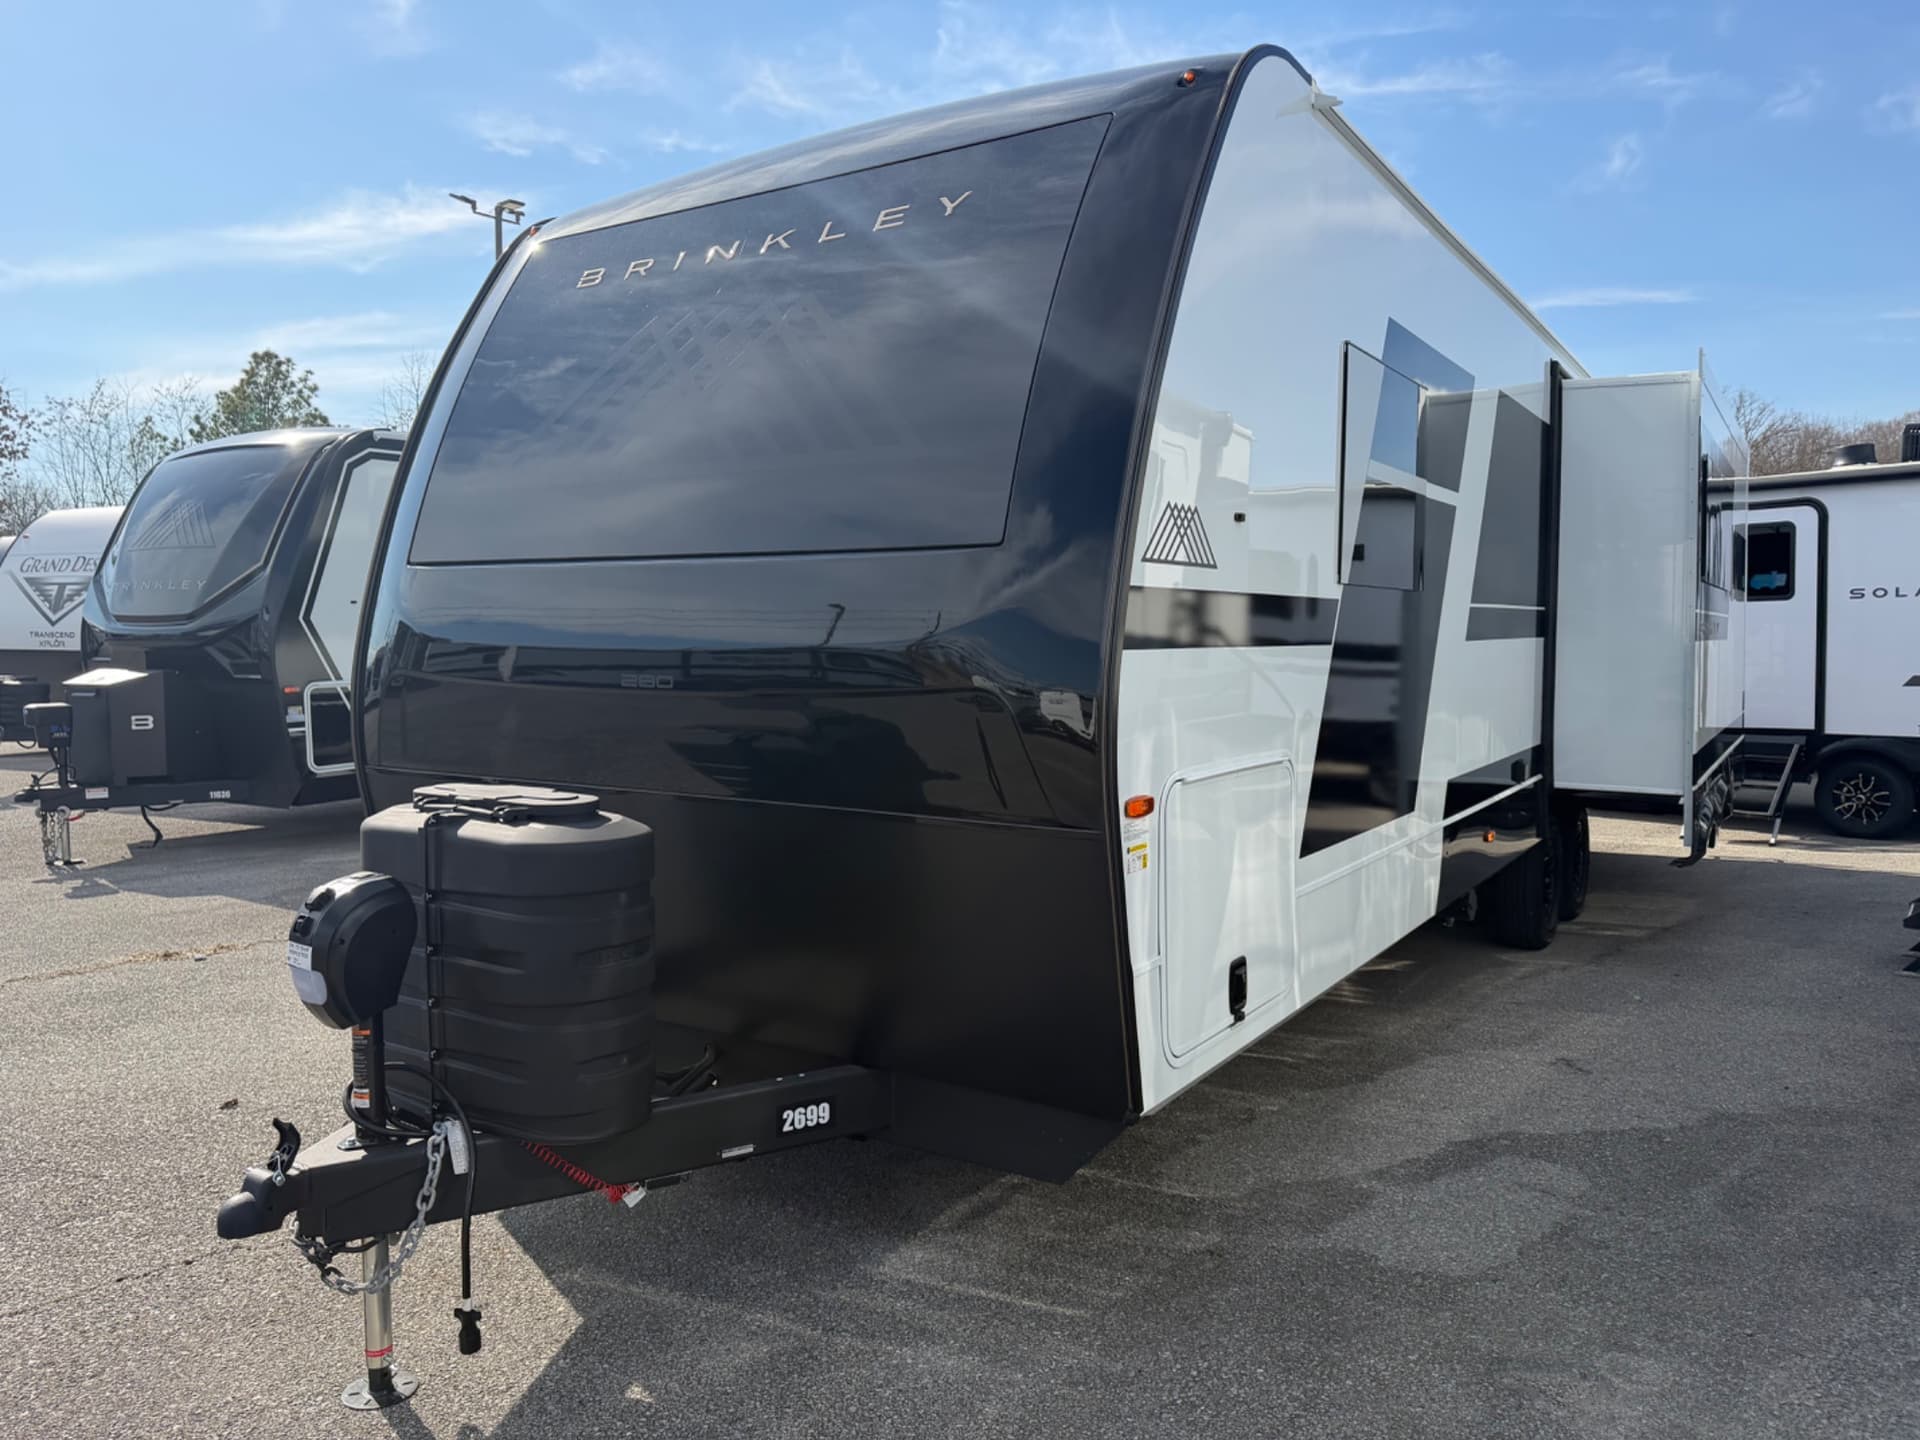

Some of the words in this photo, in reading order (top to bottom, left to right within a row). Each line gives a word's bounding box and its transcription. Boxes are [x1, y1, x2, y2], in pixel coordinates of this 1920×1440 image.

[576, 190, 973, 289] BRINKLEY
[20, 556, 71, 573] GRAND
[29, 631, 76, 639] TRANSCEND
[130, 714, 154, 731] B
[782, 1102, 831, 1132] 2699
